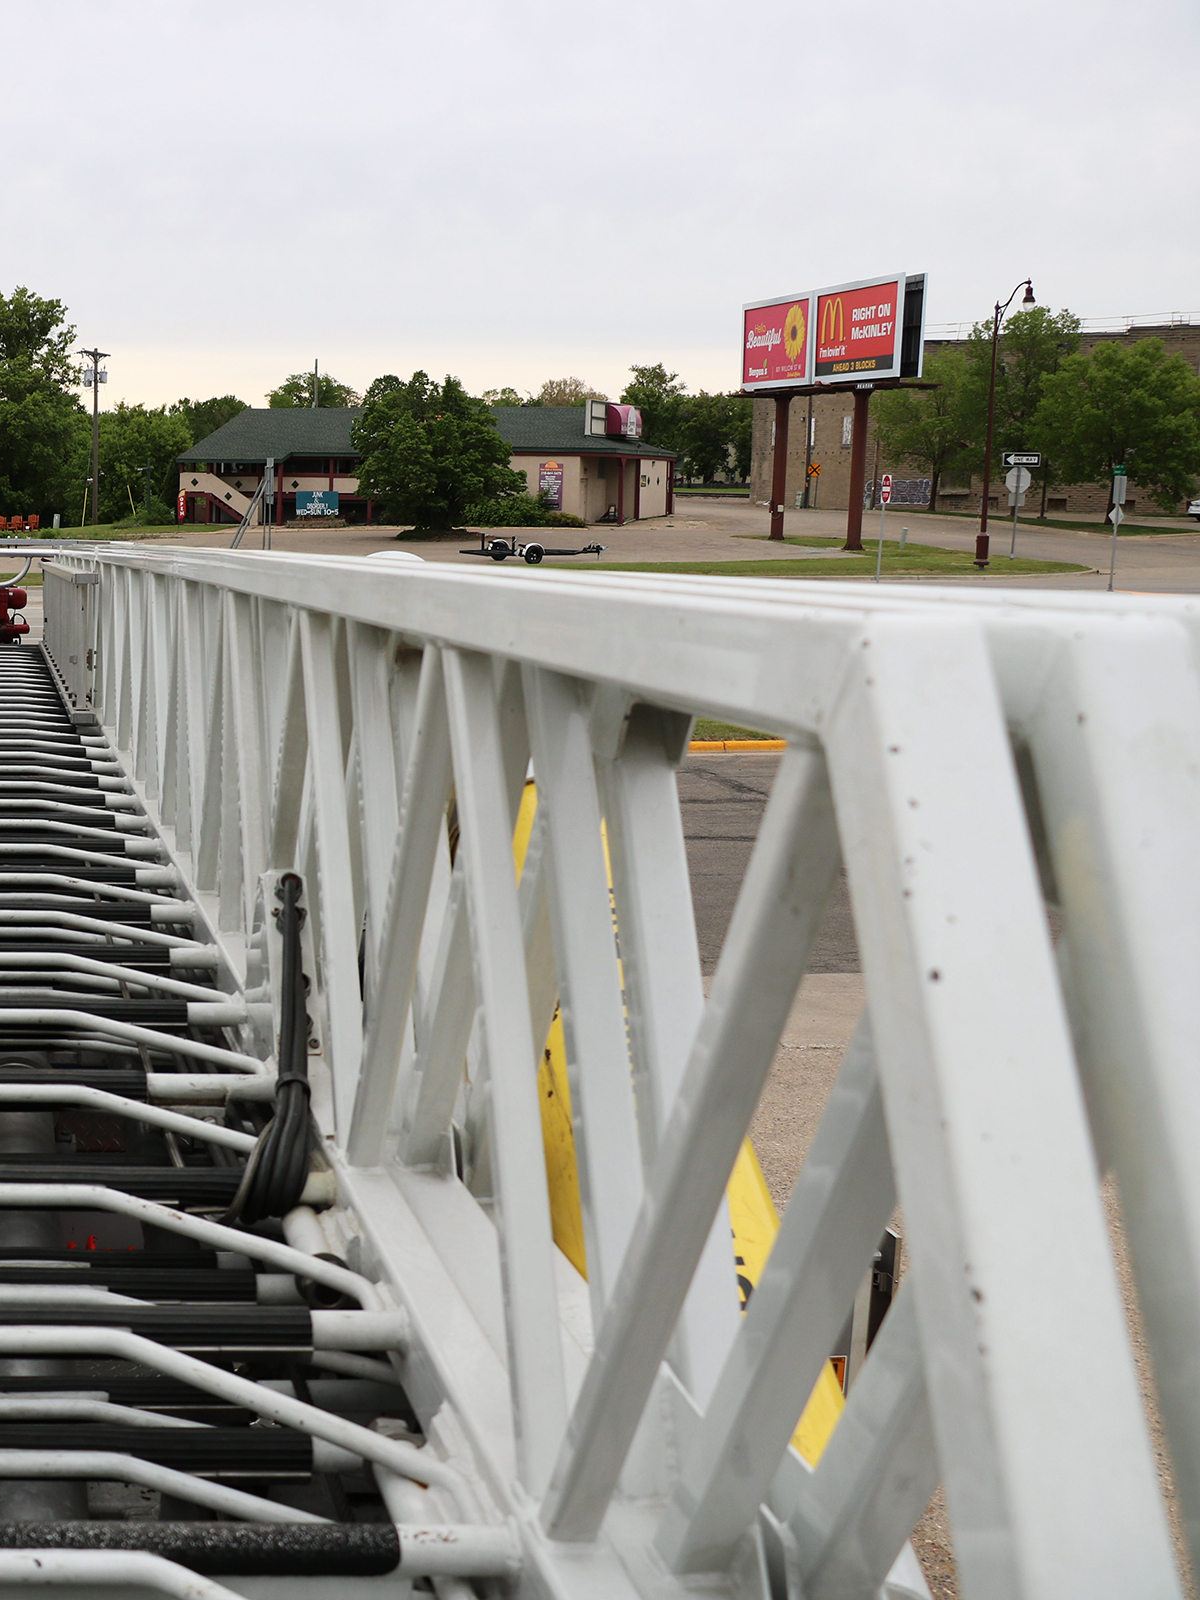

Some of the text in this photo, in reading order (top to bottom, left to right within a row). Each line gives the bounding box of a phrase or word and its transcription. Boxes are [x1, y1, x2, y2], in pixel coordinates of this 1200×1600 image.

[852, 303, 891, 322] RIGHT ON
[746, 328, 782, 351] Beautiful
[851, 321, 893, 340] McKINLEY
[832, 359, 876, 372] AHEAD 3 BLOCKS
